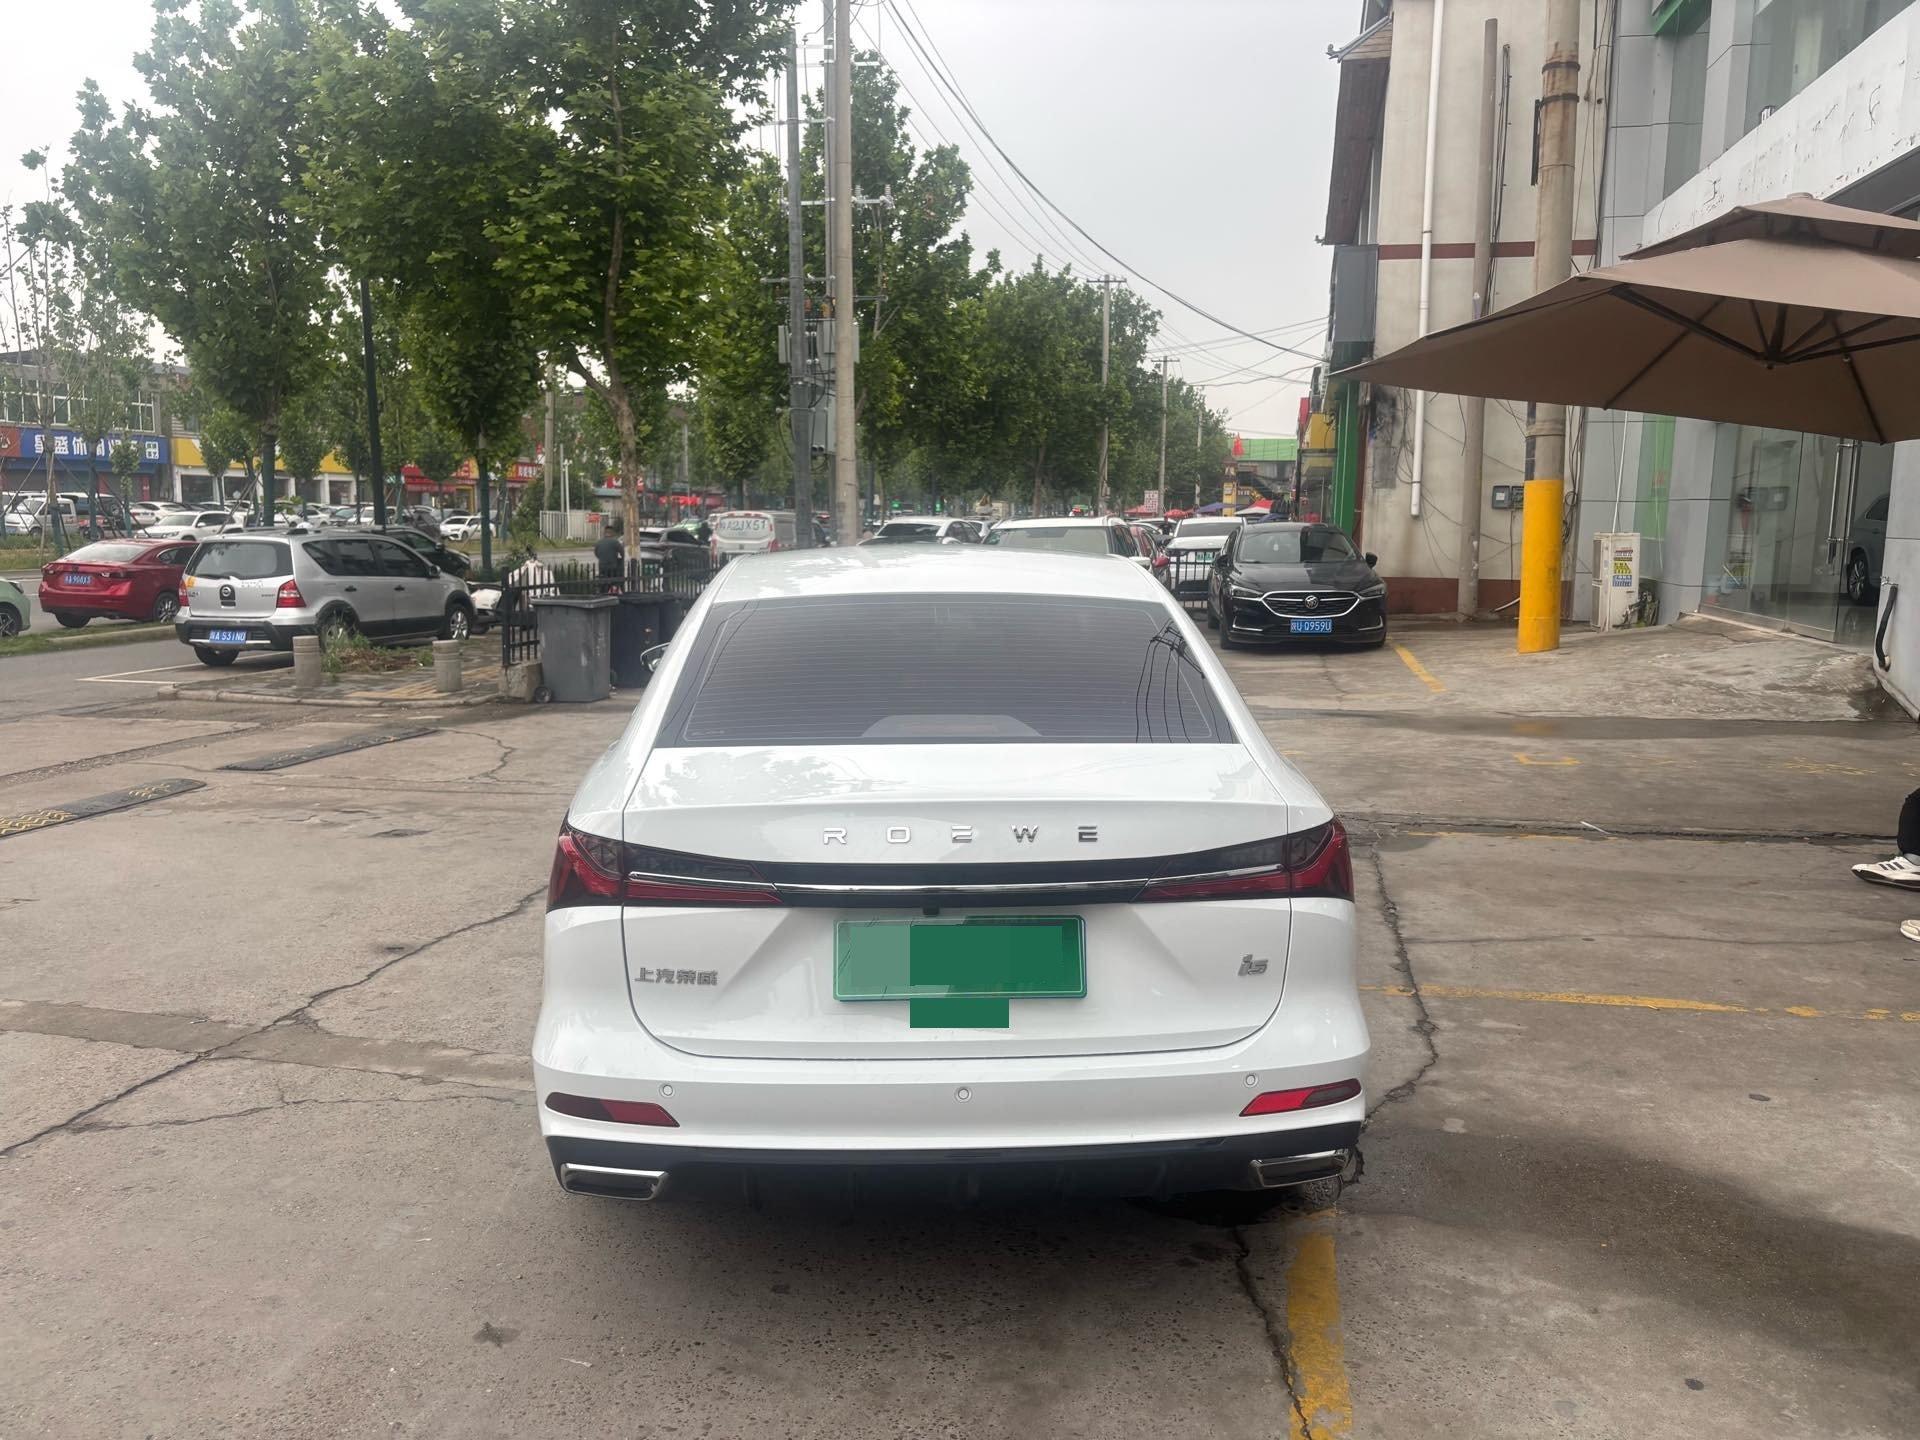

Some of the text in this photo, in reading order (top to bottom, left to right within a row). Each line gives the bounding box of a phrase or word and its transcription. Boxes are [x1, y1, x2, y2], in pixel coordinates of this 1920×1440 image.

[823, 824, 1098, 845] ROEWE
[634, 966, 719, 986] 上汽荣威
